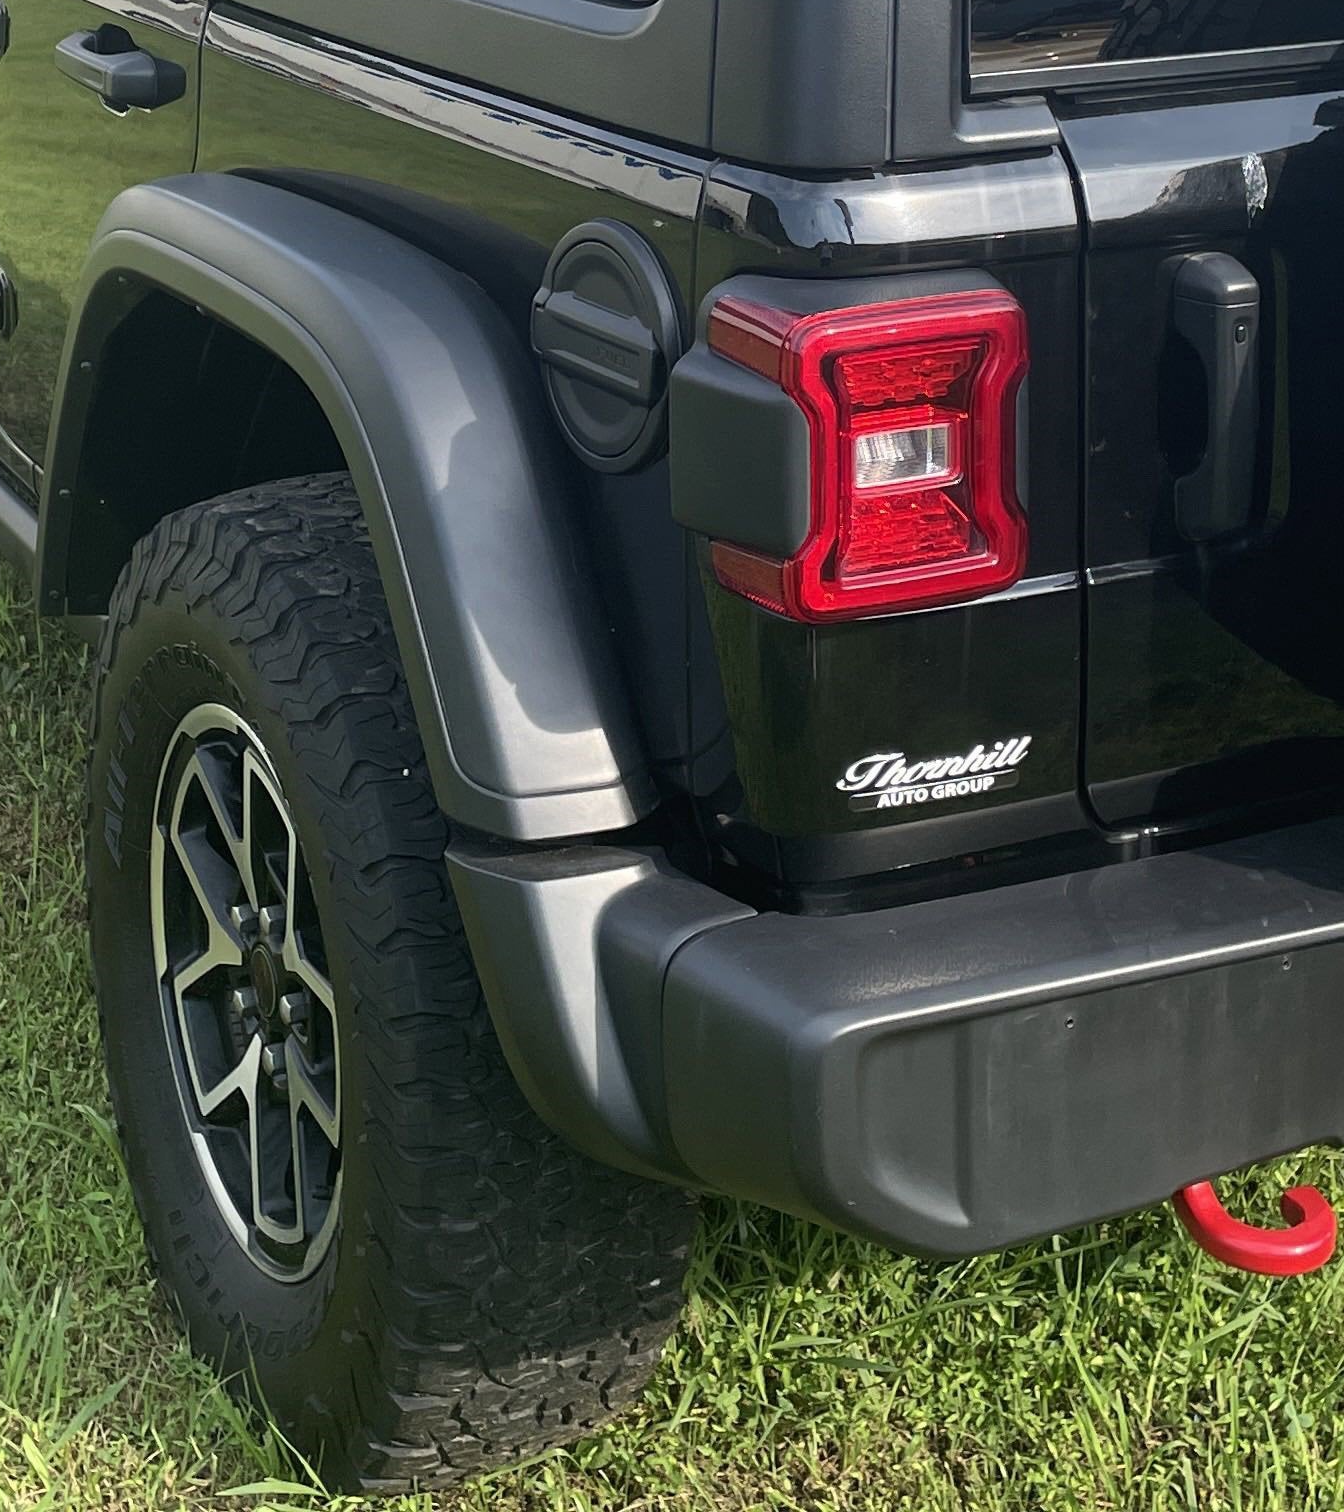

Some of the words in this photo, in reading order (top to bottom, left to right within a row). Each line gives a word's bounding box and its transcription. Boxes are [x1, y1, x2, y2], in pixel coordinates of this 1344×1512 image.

[836, 736, 1033, 791] Thornhill
[876, 789, 929, 809] AUTO
[931, 776, 995, 800] GROUP
